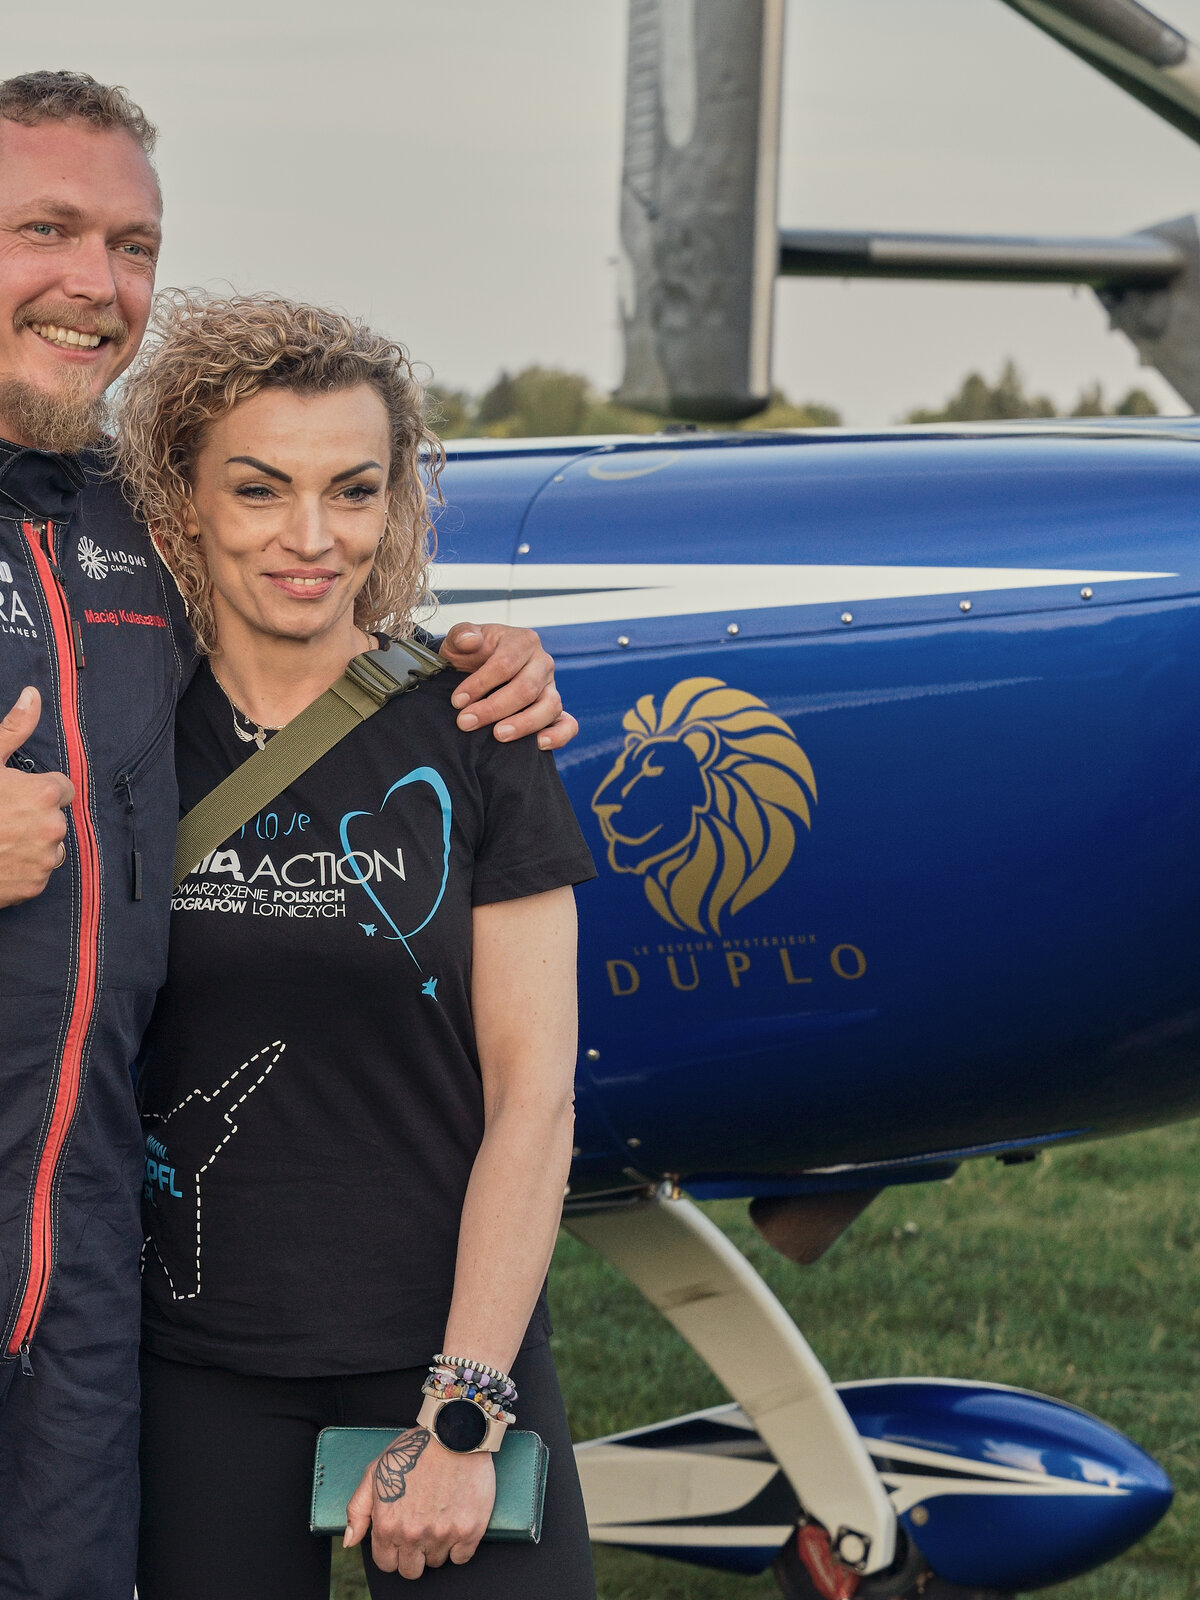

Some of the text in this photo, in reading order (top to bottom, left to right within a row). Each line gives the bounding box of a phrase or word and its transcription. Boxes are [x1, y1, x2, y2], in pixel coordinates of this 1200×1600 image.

[84, 609, 119, 626] Maciej
[189, 847, 406, 888] IR ACTION
[273, 888, 345, 903] POLSKICH
[252, 902, 346, 918] LOTNICZYCH
[606, 943, 867, 996] DUPLO
